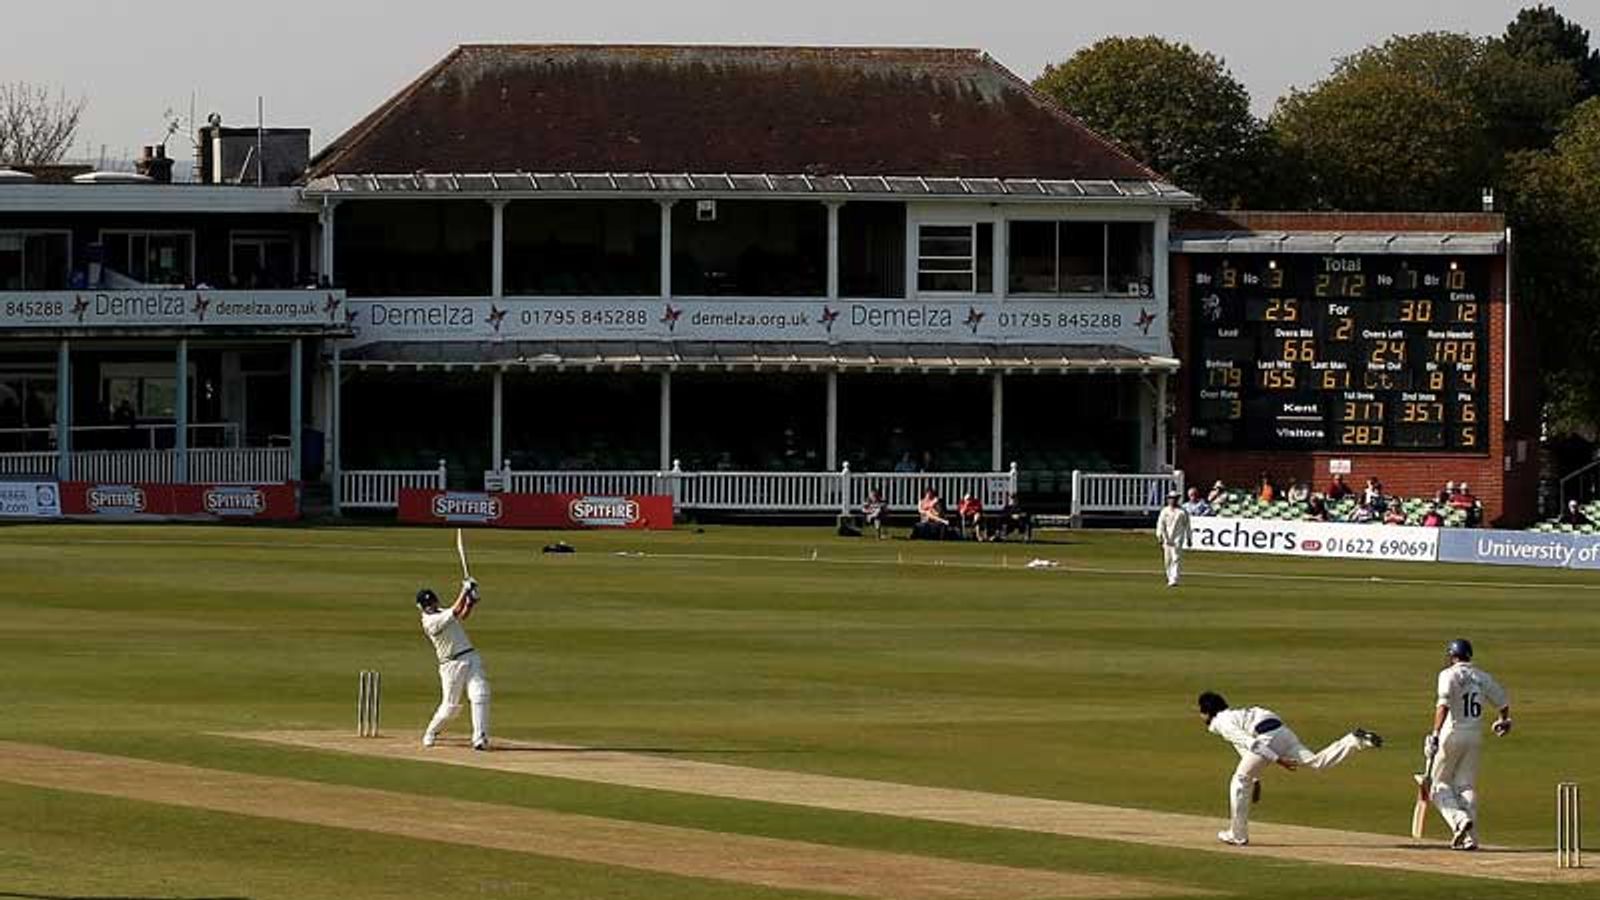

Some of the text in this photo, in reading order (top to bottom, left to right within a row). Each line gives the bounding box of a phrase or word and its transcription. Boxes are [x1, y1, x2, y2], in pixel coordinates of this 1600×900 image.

[1323, 258, 1362, 272] Total
[1271, 269, 1283, 288] 3
[1315, 274, 1367, 297] 212
[1445, 270, 1466, 290] 10
[6, 301, 64, 317] 845288
[95, 293, 185, 315] Demelza
[215, 301, 318, 318] demelza.org.uk
[1265, 299, 1297, 321] 25
[1328, 304, 1350, 316] For
[1400, 299, 1432, 322] 30
[1458, 302, 1478, 322] 12
[371, 304, 474, 326] Demelza
[521, 309, 648, 325] 01795 845288
[691, 311, 808, 328] demelza.org.uk
[851, 304, 952, 327] Demelza
[998, 312, 1122, 328] 01795 845288
[1335, 318, 1351, 340] 2
[1284, 340, 1314, 361] 66
[1372, 341, 1405, 362] 24
[1263, 370, 1296, 390] 155
[1323, 371, 1350, 390] 61
[1430, 371, 1444, 390] 8
[1463, 371, 1476, 390] 4
[1231, 400, 1241, 420] 3
[1283, 404, 1318, 414] Kent
[1343, 402, 1384, 422] 317
[1402, 402, 1444, 423] 357
[1462, 403, 1475, 422] 6
[1276, 428, 1325, 438] Visitors
[1461, 427, 1475, 446] 5
[90, 491, 141, 508] SPITFIRE
[207, 491, 262, 508] SPITFIRE
[436, 500, 496, 515] SPITFIRE
[573, 501, 634, 518] SPITFIRE
[1326, 537, 1375, 555] 01622
[1380, 540, 1435, 556] 690691
[1478, 539, 1598, 566] University of
[1462, 692, 1481, 718] 16
